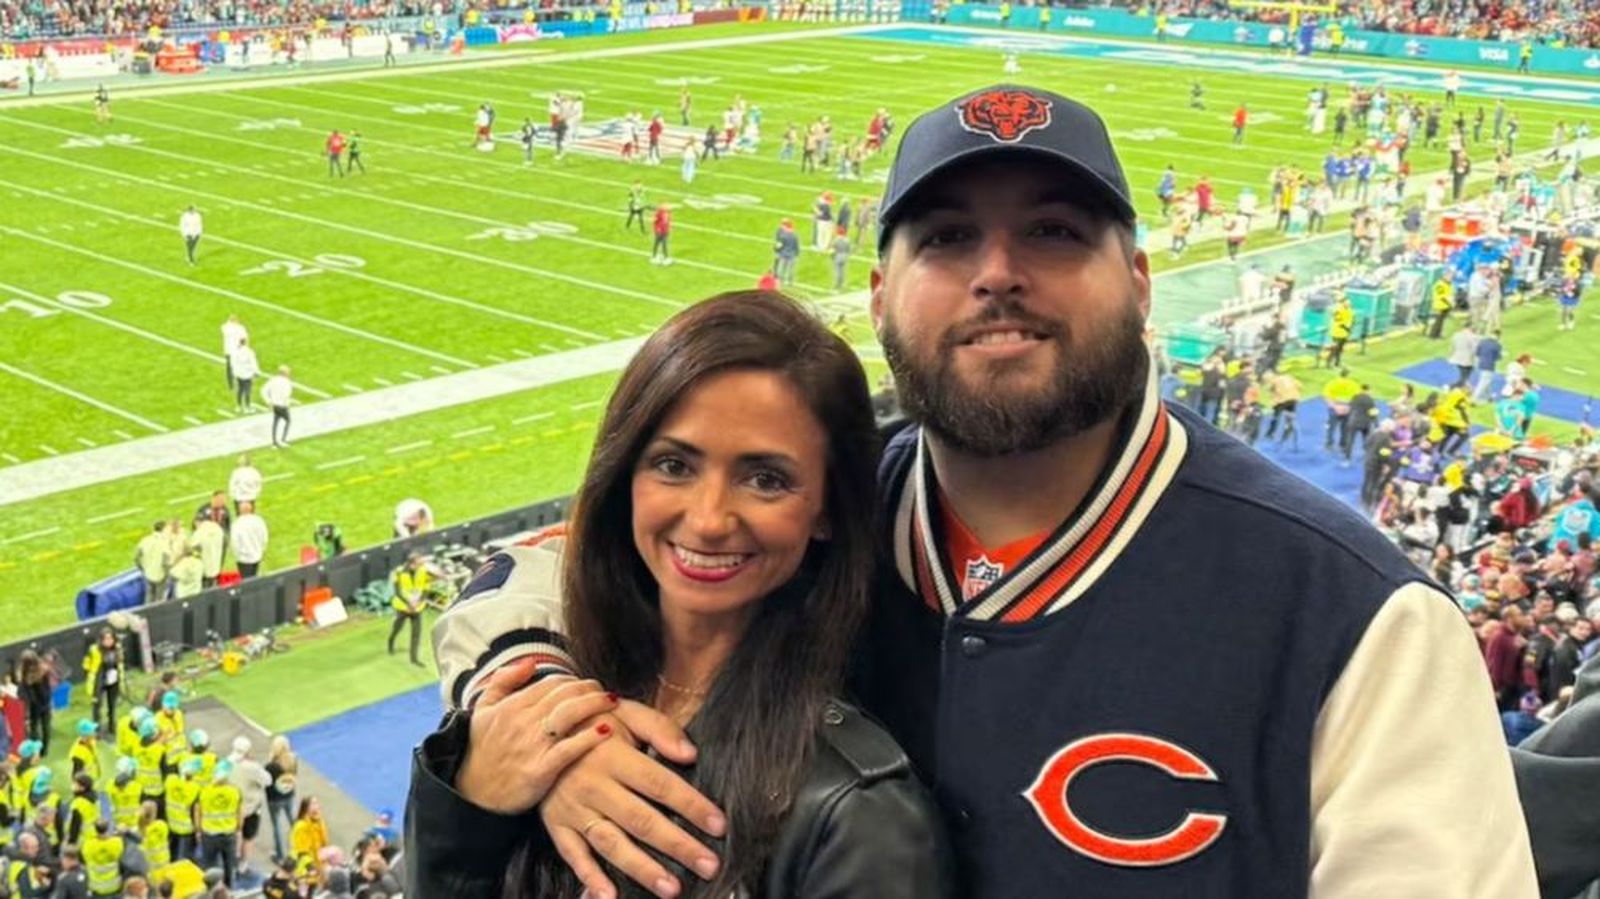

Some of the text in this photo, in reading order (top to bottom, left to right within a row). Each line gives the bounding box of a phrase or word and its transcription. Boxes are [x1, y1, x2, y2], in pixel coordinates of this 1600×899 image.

[261, 253, 367, 277] 20
[1, 290, 112, 317] 10
[1021, 732, 1228, 867] C
